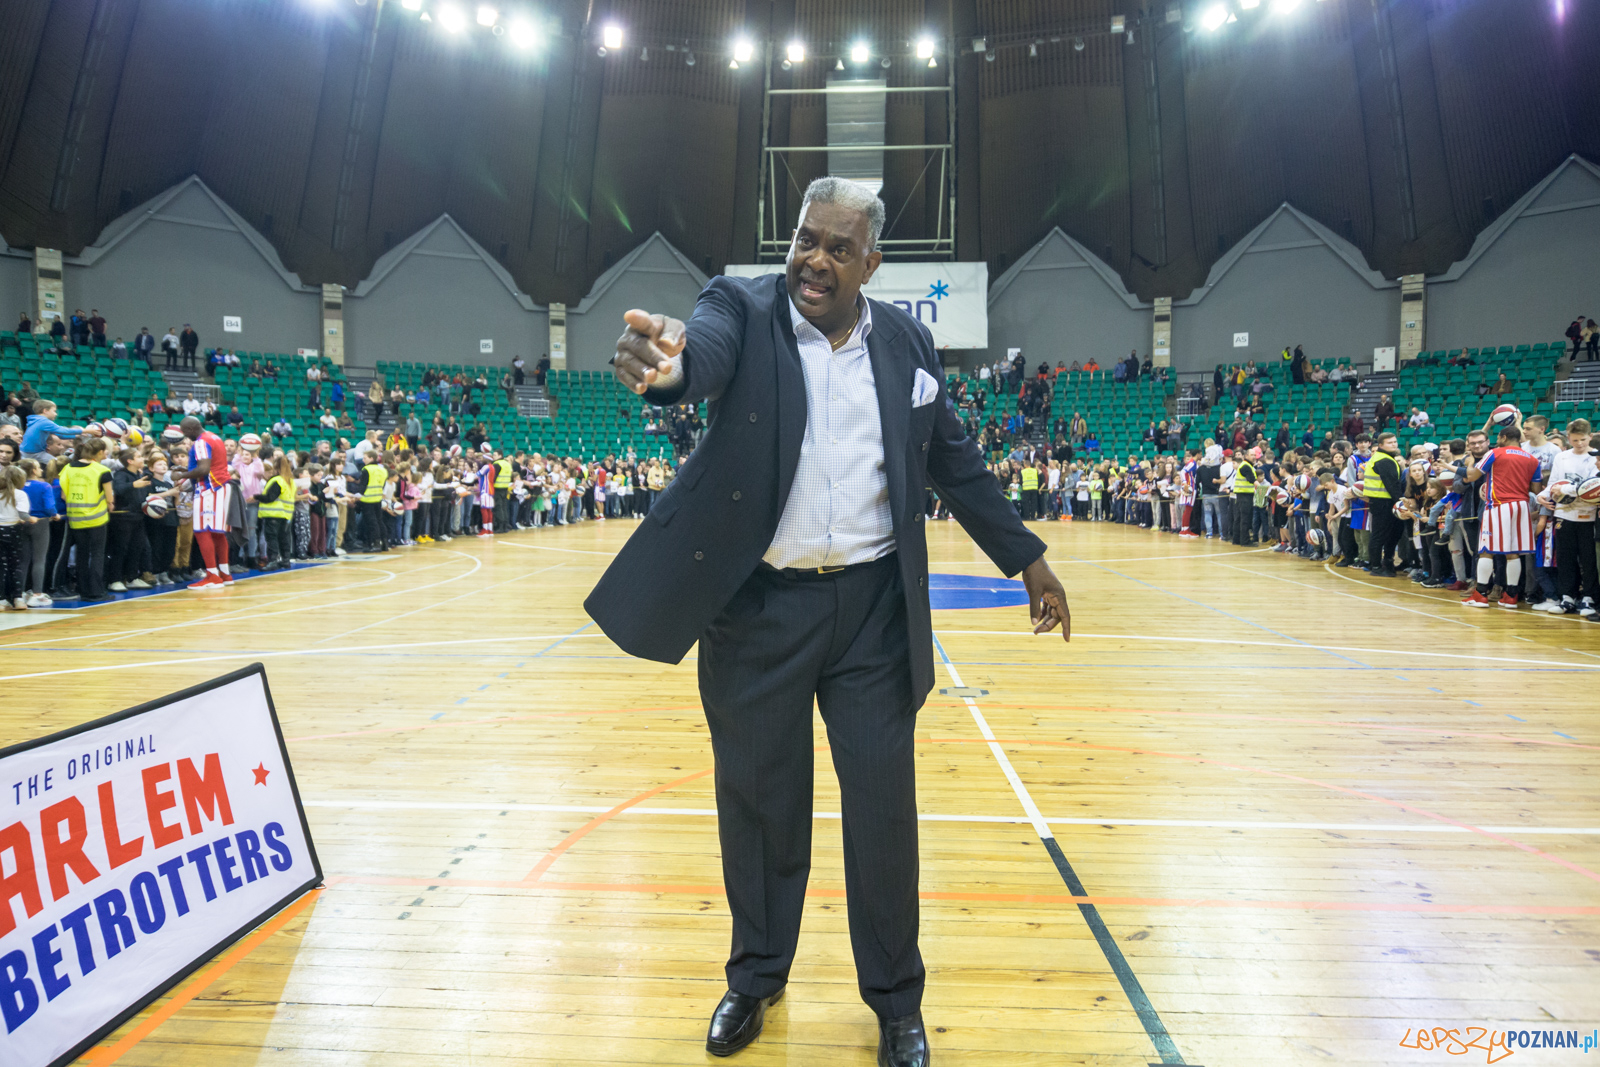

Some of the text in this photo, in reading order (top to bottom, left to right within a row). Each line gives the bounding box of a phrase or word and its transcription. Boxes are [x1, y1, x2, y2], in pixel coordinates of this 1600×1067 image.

[0, 752, 235, 939] ARLEM
[13, 734, 156, 805] THE ORIGINAL
[0, 821, 293, 1034] BETROTTERS
